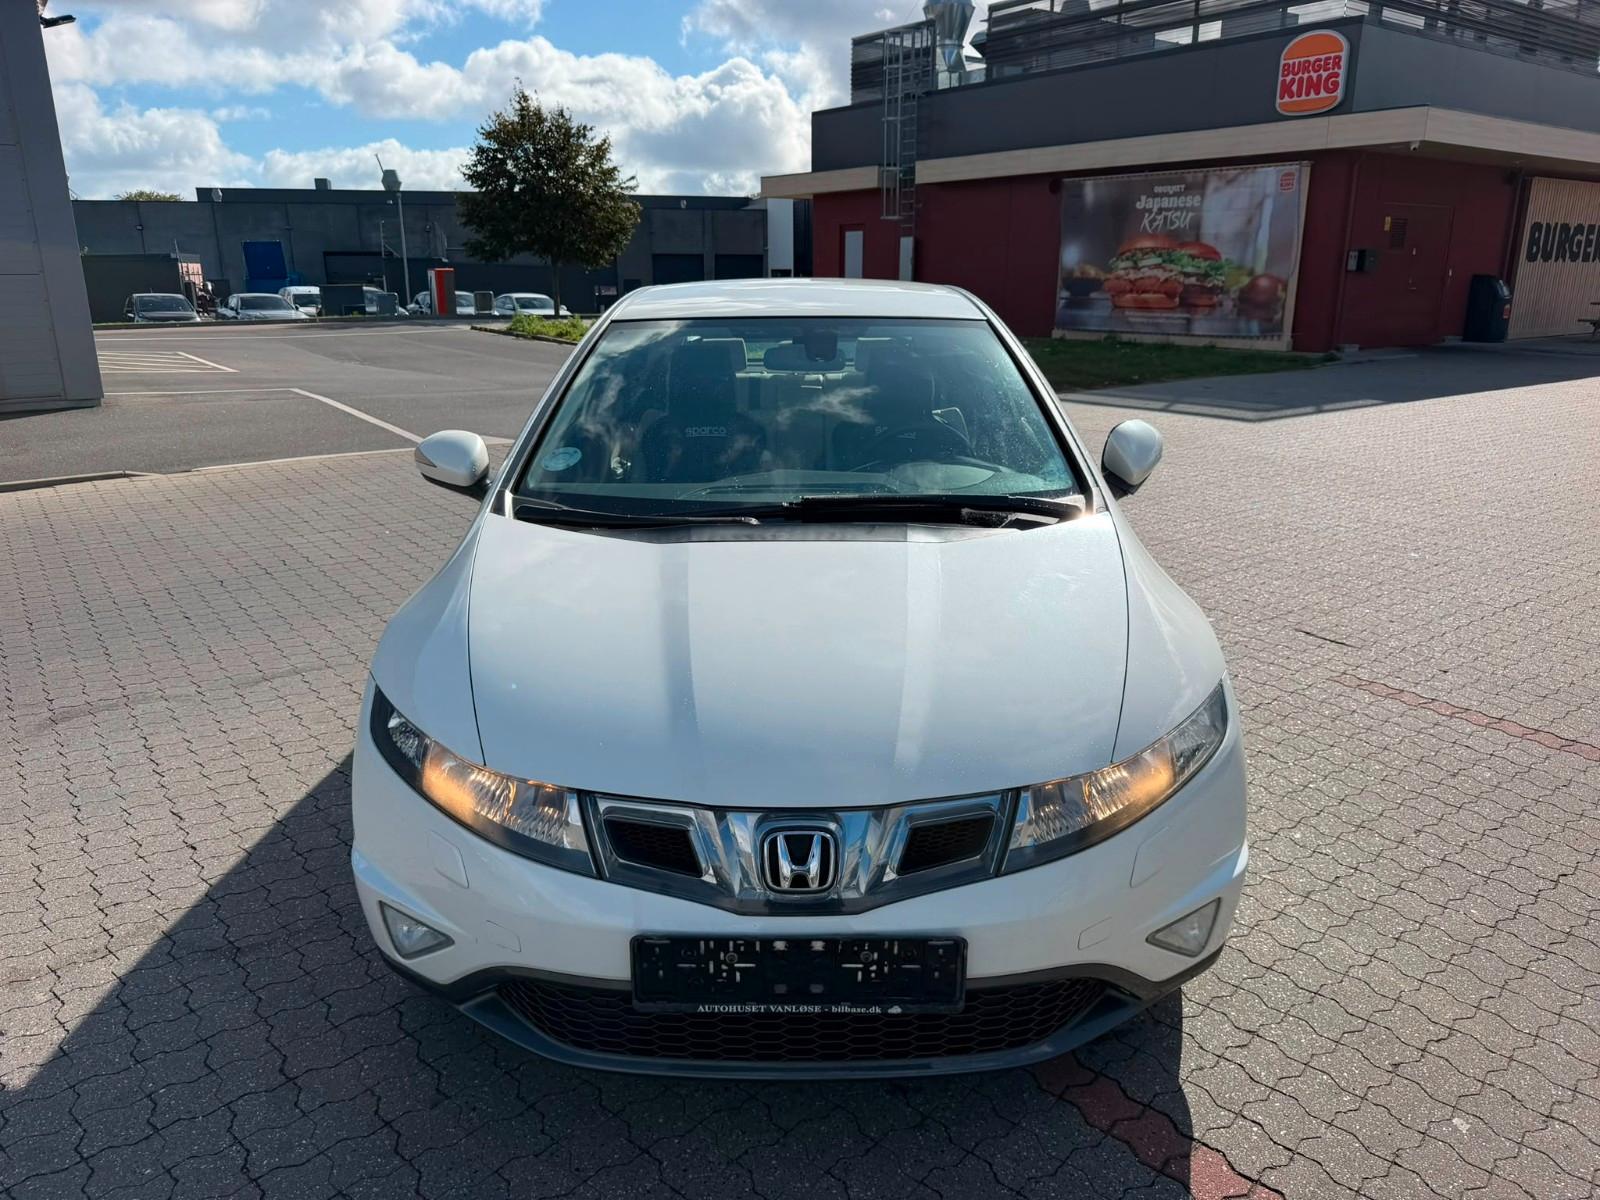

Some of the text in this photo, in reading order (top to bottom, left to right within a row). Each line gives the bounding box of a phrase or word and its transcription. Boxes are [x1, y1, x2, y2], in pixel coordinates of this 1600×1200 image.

[1281, 55, 1343, 78] BURGER
[1279, 71, 1341, 100] KING
[1136, 194, 1202, 212] Japanese
[1139, 210, 1196, 233] KATSU
[697, 1004, 767, 1013] AUTOHUSET
